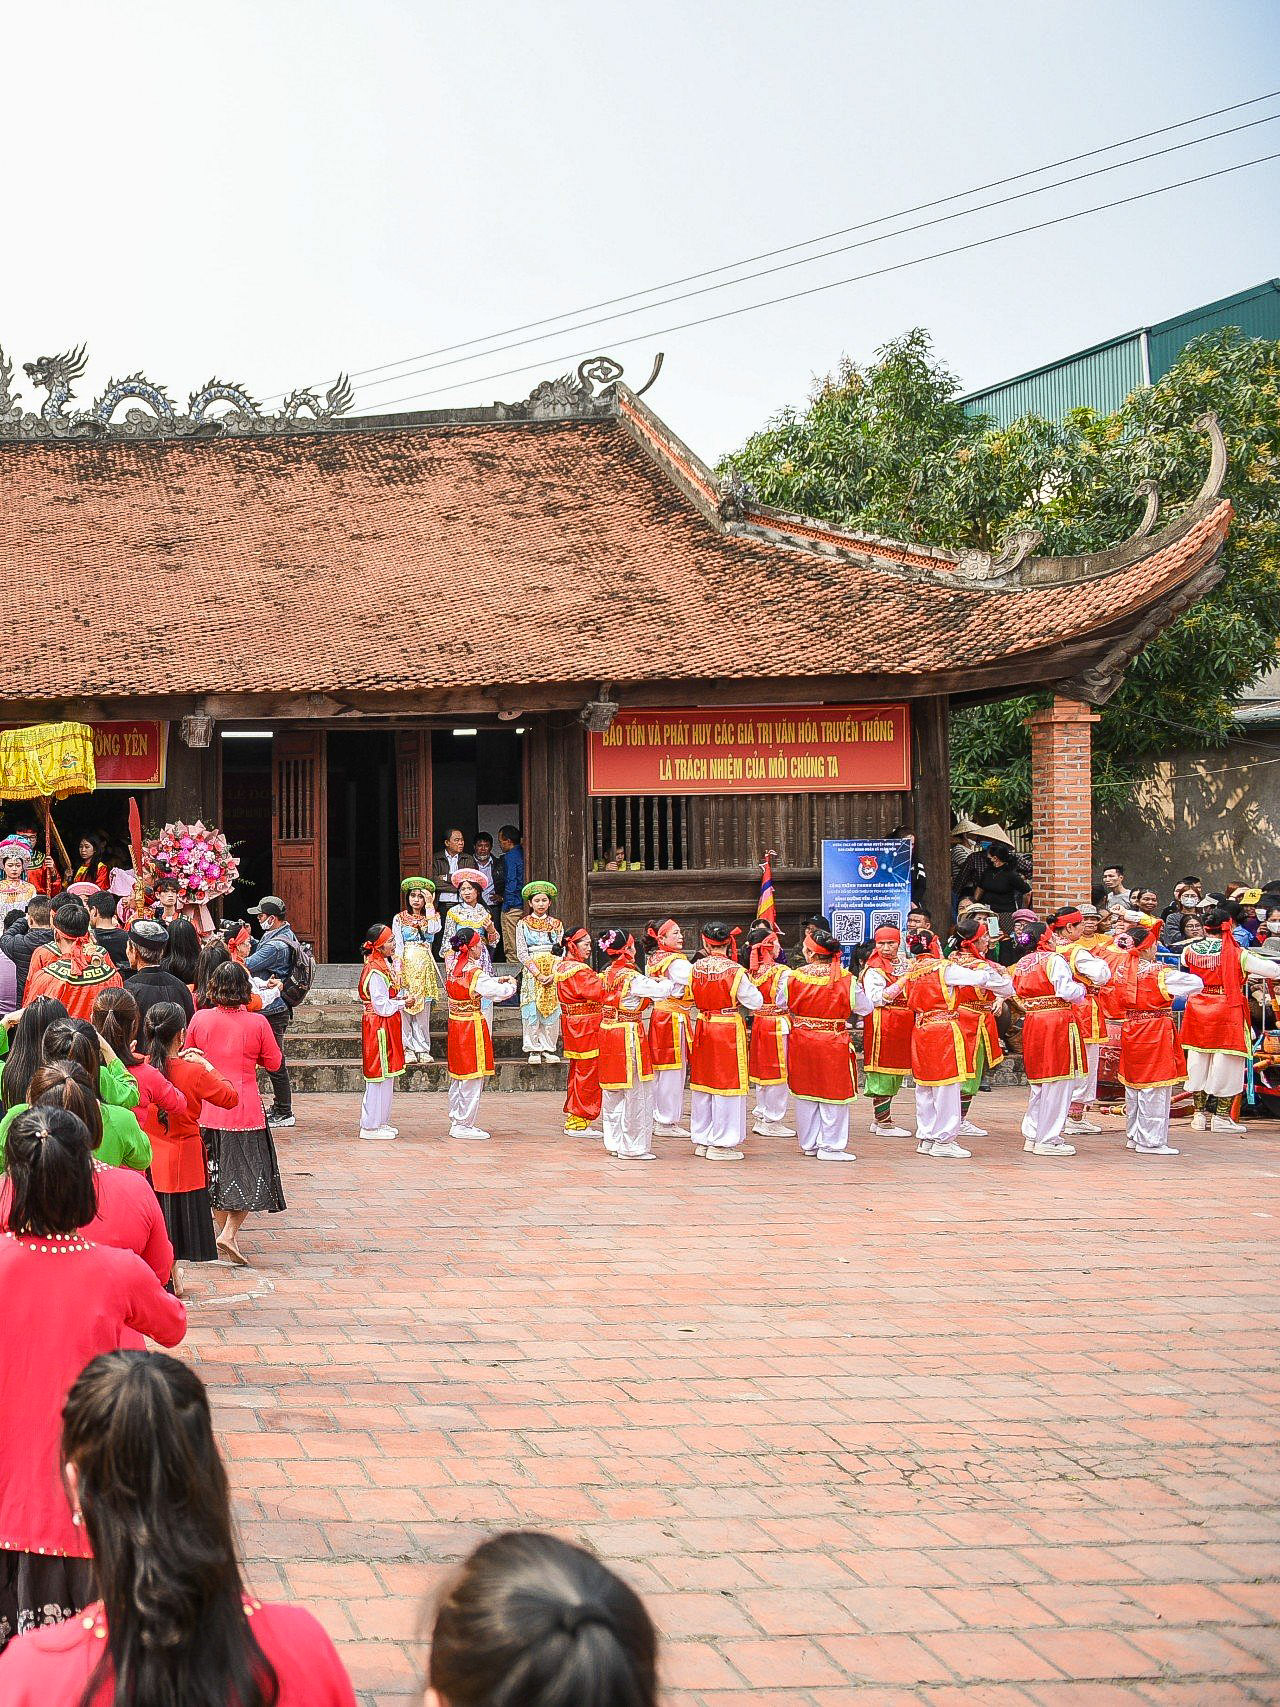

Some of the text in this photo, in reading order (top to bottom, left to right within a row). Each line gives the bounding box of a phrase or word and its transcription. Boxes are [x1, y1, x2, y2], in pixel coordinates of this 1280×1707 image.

[94, 727, 120, 756] ỜNG
[123, 727, 148, 756] YÊN
[647, 719, 661, 746] VÀ
[663, 719, 689, 745] PHÁT
[692, 723, 711, 745] HUY
[714, 718, 734, 745] CÁC
[737, 719, 755, 744] GIÁ
[757, 722, 772, 748] TRỊ
[775, 718, 796, 744] VĂN
[798, 717, 819, 743] HÓA
[659, 749, 839, 784] LÀ TRÁCH NHIỆM CỦA MỖI CHÚNG TA
